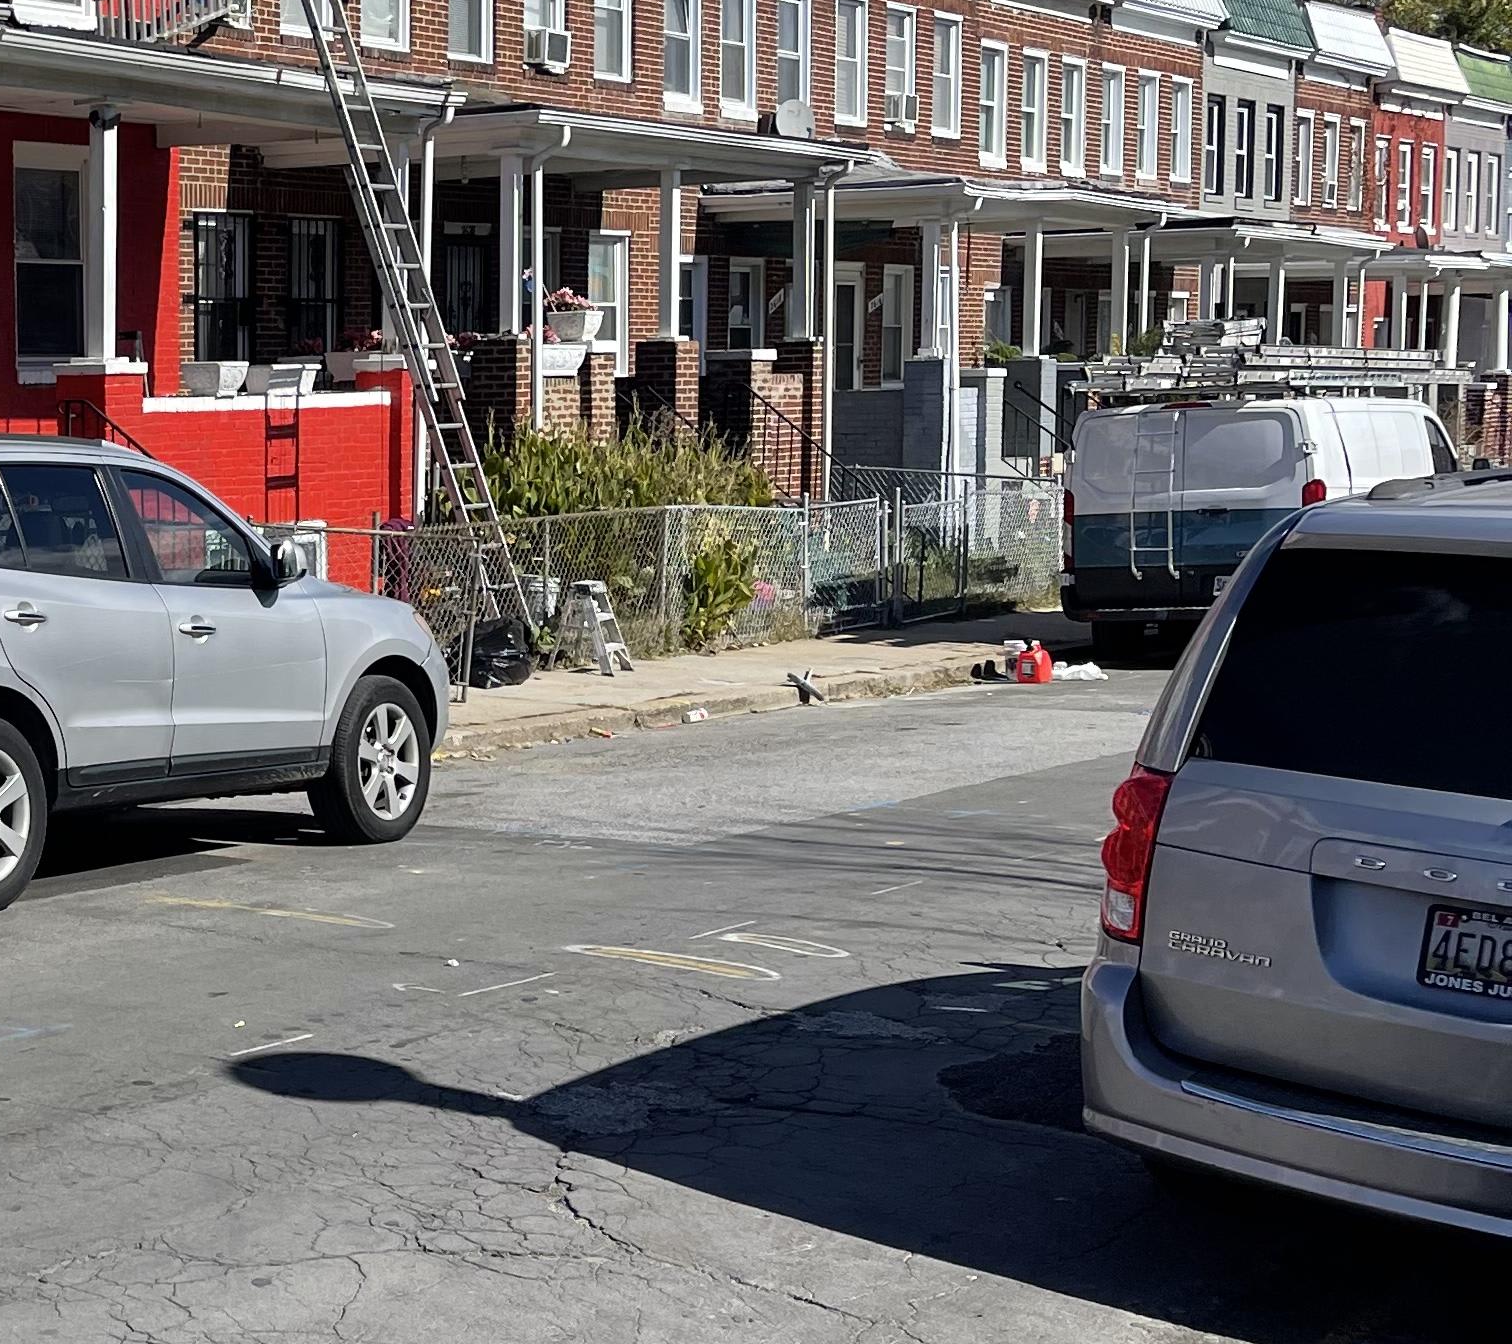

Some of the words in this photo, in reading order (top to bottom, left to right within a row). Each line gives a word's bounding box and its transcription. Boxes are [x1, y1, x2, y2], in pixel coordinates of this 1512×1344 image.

[1168, 929, 1228, 949] GRAND
[1168, 938, 1272, 967] CARAVAN
[1423, 972, 1484, 993] JONES
